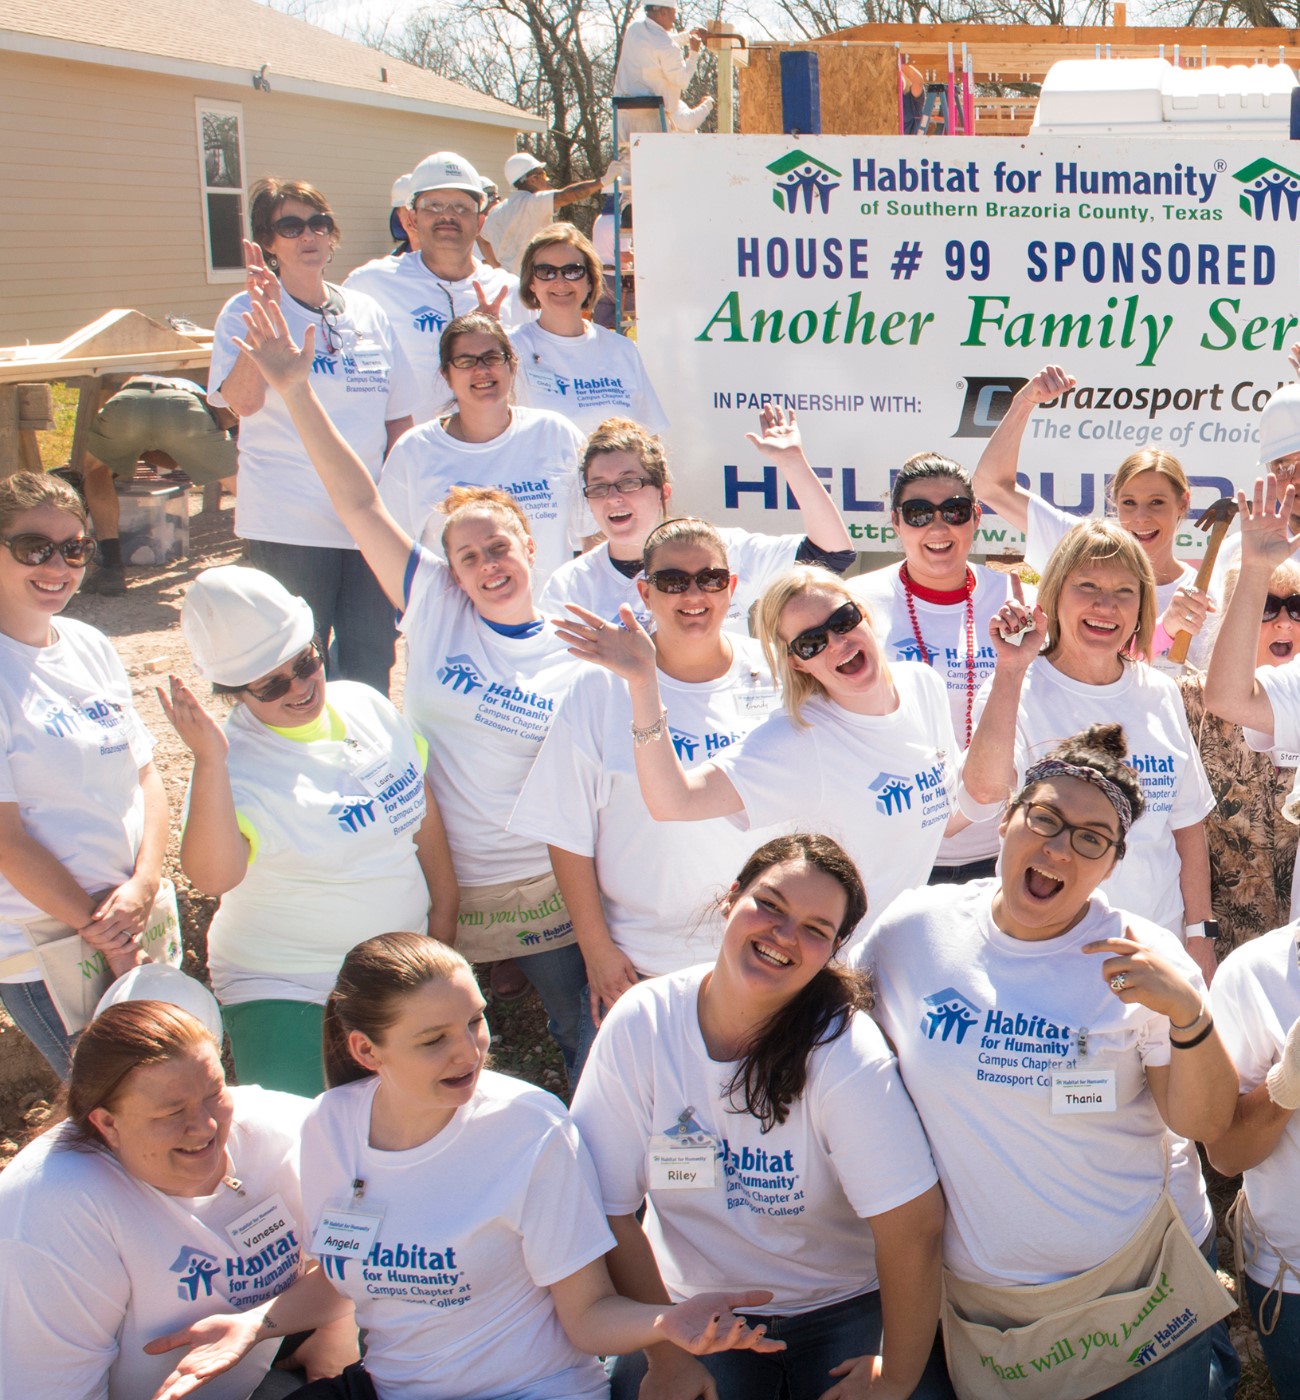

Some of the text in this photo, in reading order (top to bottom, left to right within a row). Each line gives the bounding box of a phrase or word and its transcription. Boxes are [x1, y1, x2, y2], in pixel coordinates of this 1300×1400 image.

[853, 158, 979, 193] Habitat
[994, 162, 1041, 194] for
[861, 200, 1223, 223] of Southern Brazoria County, Texas
[737, 236, 869, 280] HOUSE
[890, 241, 923, 280] #
[945, 239, 991, 281] 99
[1026, 240, 1276, 286] SPONSORED
[694, 290, 935, 346] Another
[960, 294, 1174, 367] Family
[574, 377, 623, 389] Habitat
[714, 392, 922, 414] IN PARTNERSHIP WITH:
[1031, 418, 1260, 447] The College of Choic
[498, 479, 550, 494] abitat
[525, 502, 550, 511] Chapter
[535, 512, 558, 520] College
[947, 660, 961, 668] for
[487, 682, 554, 712] Habitat
[478, 703, 543, 731] Campus Chapter
[482, 693, 550, 724] for Humanity
[474, 713, 518, 735] Brazosport
[921, 792, 933, 804] for
[1143, 789, 1170, 800] Chapter
[384, 801, 398, 813] for
[389, 806, 414, 824] Campus
[922, 800, 945, 815] Campus
[485, 910, 517, 929] you
[984, 1009, 1070, 1039] Habitat
[980, 1036, 1070, 1057] for Humanity
[978, 1053, 1077, 1071] Campus Chapter at
[976, 1069, 1033, 1087] Brazosport
[1065, 1092, 1102, 1104] Thania
[668, 1170, 697, 1183] Riley
[752, 1190, 804, 1205] Chapter at
[768, 1204, 805, 1217] College
[243, 1219, 286, 1248] Vanessa
[324, 1235, 360, 1250] Angela
[362, 1242, 457, 1270] Habitat
[229, 1279, 249, 1293] for
[362, 1268, 459, 1286] for Humanity
[229, 1291, 271, 1306] Campus
[366, 1283, 472, 1297] Campus Chapter at
[430, 1295, 472, 1308] College
[1153, 1307, 1195, 1344] Habitat
[1161, 1315, 1198, 1350] for Humanity
[1029, 1337, 1075, 1373] will
[1078, 1331, 1119, 1360] you
